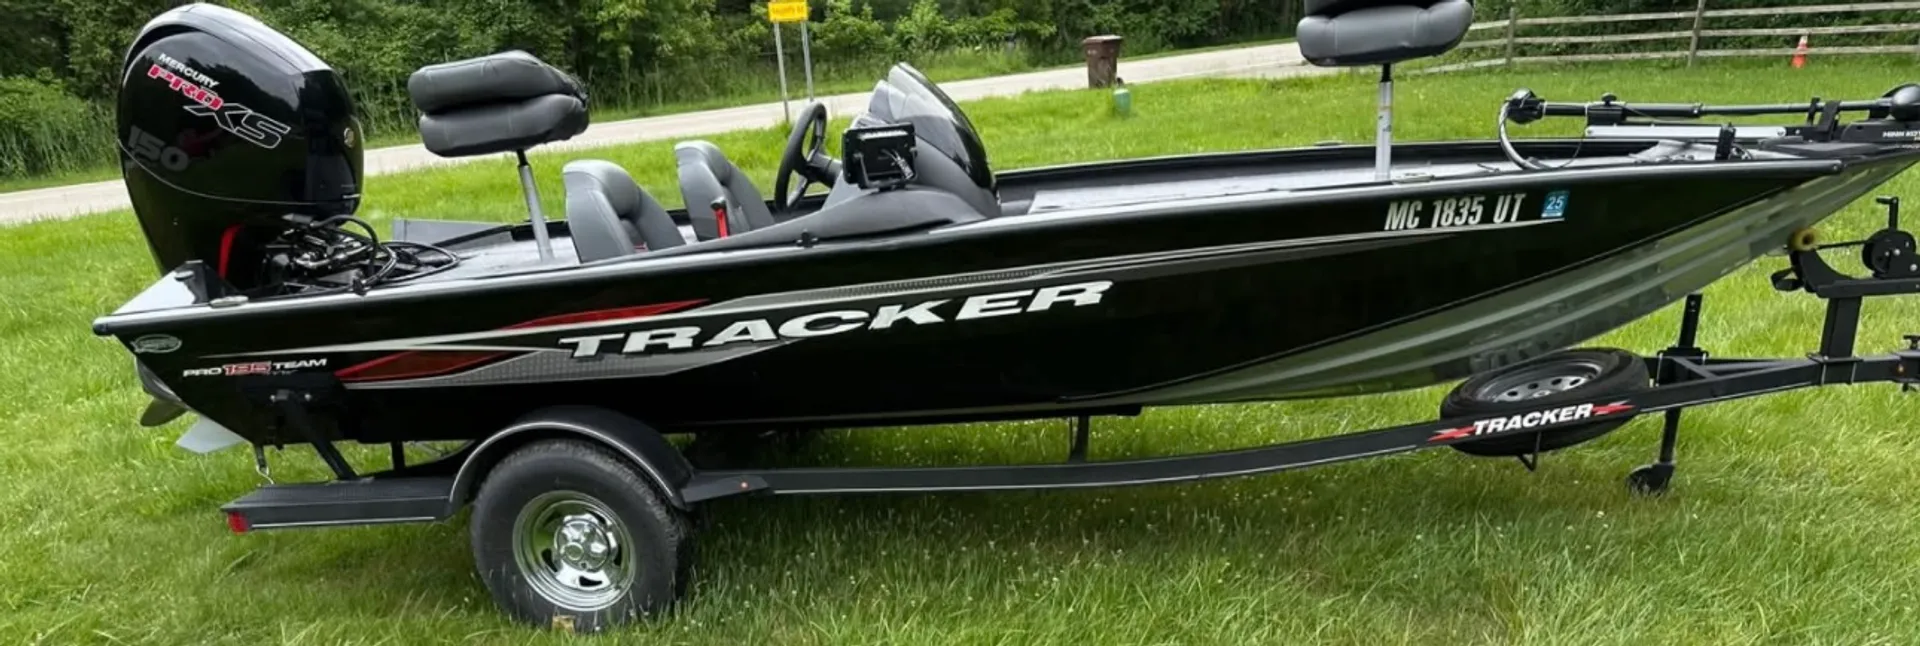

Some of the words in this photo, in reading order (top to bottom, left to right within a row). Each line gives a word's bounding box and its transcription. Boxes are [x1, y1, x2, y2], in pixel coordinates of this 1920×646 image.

[147, 63, 224, 110] PRO
[158, 53, 220, 89] MERCURY
[183, 102, 291, 149] XS
[128, 125, 189, 172] 150
[1384, 200, 1423, 231] MC
[1431, 195, 1486, 229] 1835
[1493, 192, 1527, 224] UT
[1546, 195, 1565, 210] 25
[558, 280, 1114, 358] TRACKER
[182, 367, 222, 377] PRO
[272, 358, 327, 370] TEAM
[1473, 403, 1594, 436] TRACKER
